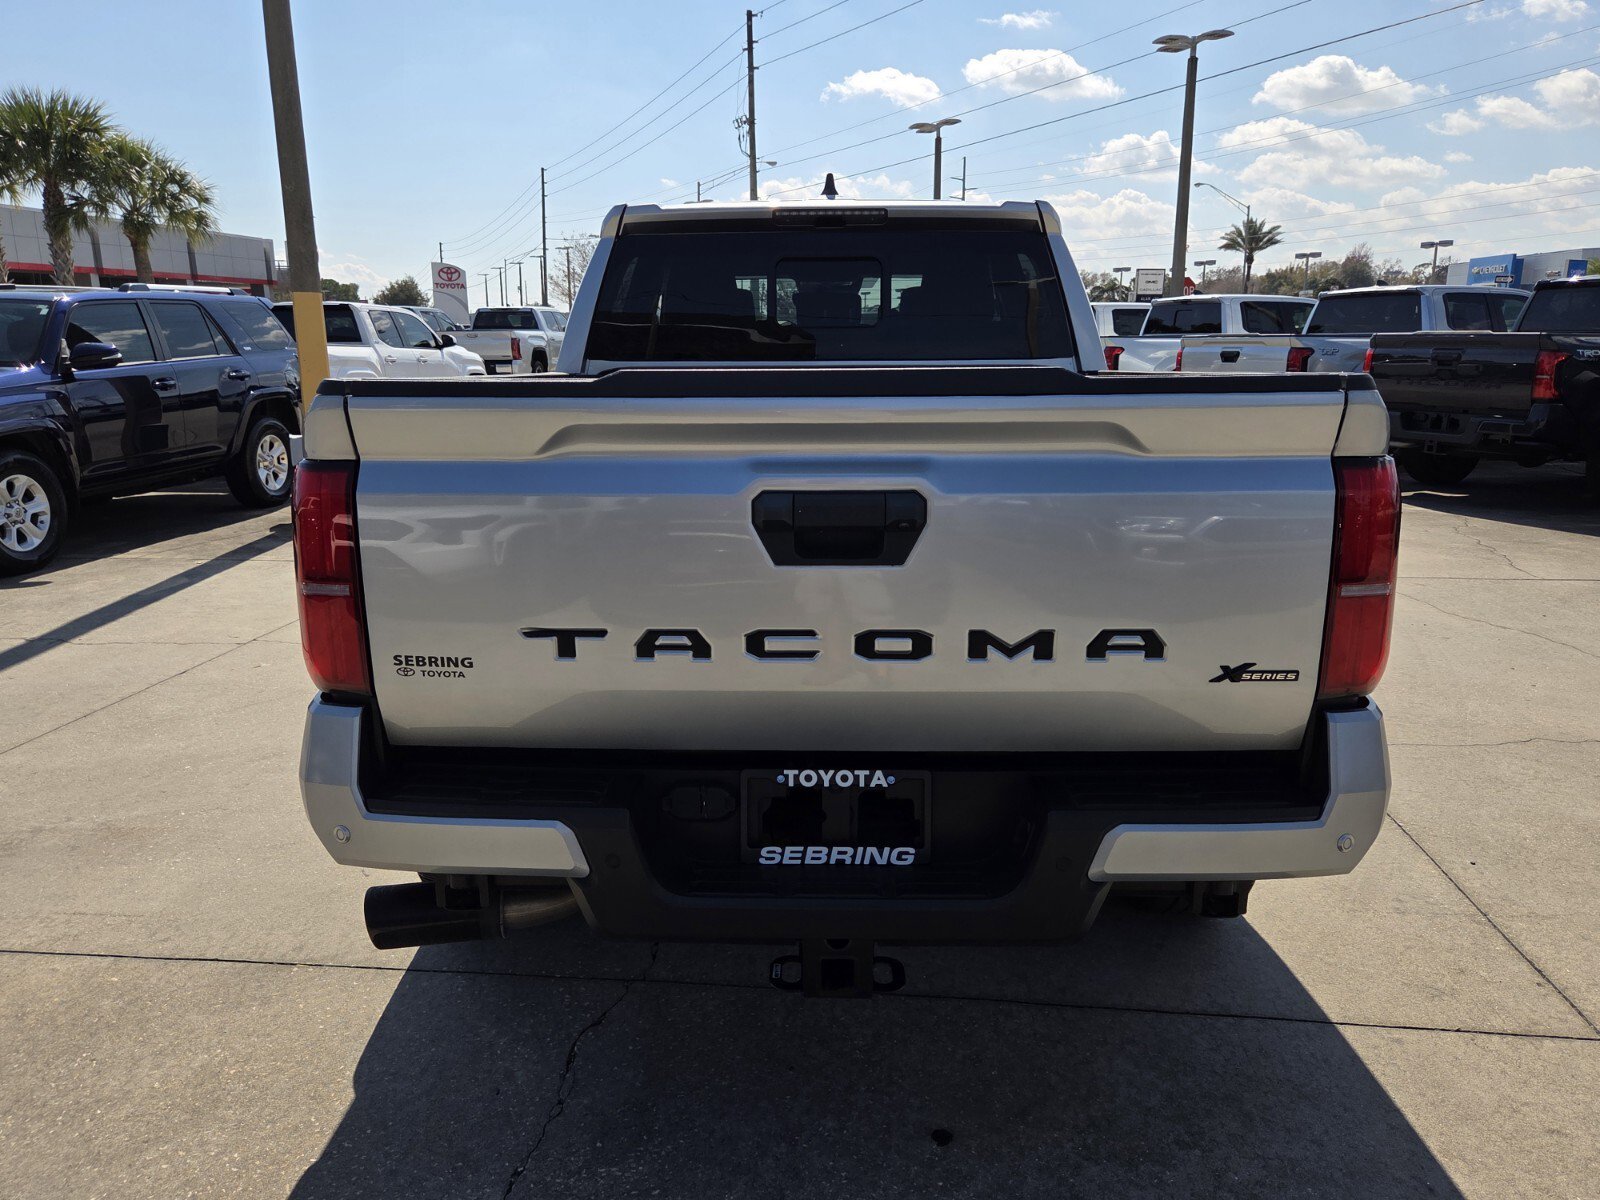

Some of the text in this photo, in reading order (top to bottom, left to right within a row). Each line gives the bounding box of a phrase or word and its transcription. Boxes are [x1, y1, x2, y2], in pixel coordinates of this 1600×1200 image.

[1480, 264, 1508, 275] CHEVROLET
[434, 282, 466, 290] TOYOTA
[519, 626, 1168, 662] TACOMA
[393, 654, 474, 668] SEBRING
[420, 669, 466, 678] TOYOTA
[783, 769, 888, 788] TOYOTA
[758, 846, 916, 866] SEBRING
